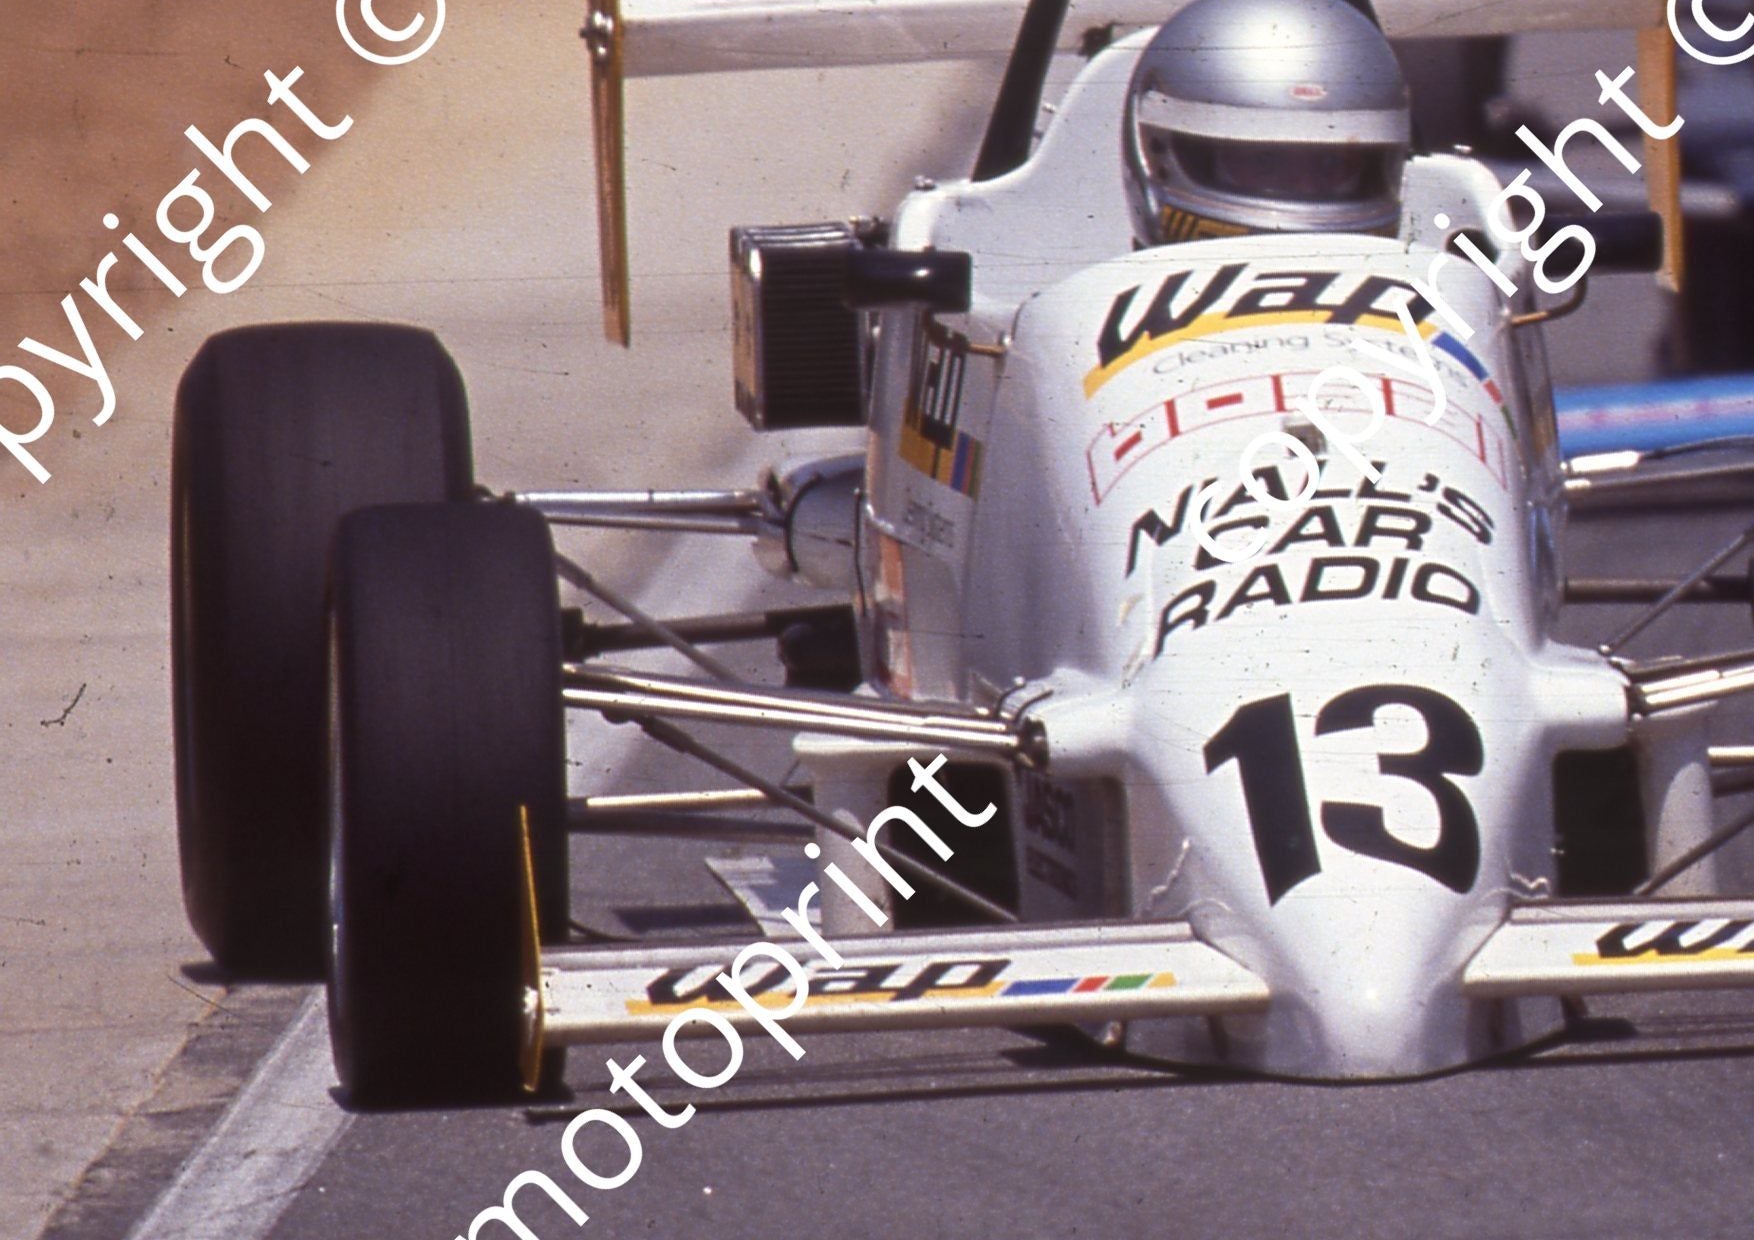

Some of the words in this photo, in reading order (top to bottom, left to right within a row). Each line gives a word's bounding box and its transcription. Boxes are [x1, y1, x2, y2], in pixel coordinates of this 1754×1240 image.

[1193, 505, 1433, 572] CAR
[1152, 556, 1482, 661] RADIO
[1202, 683, 1485, 908] 13
